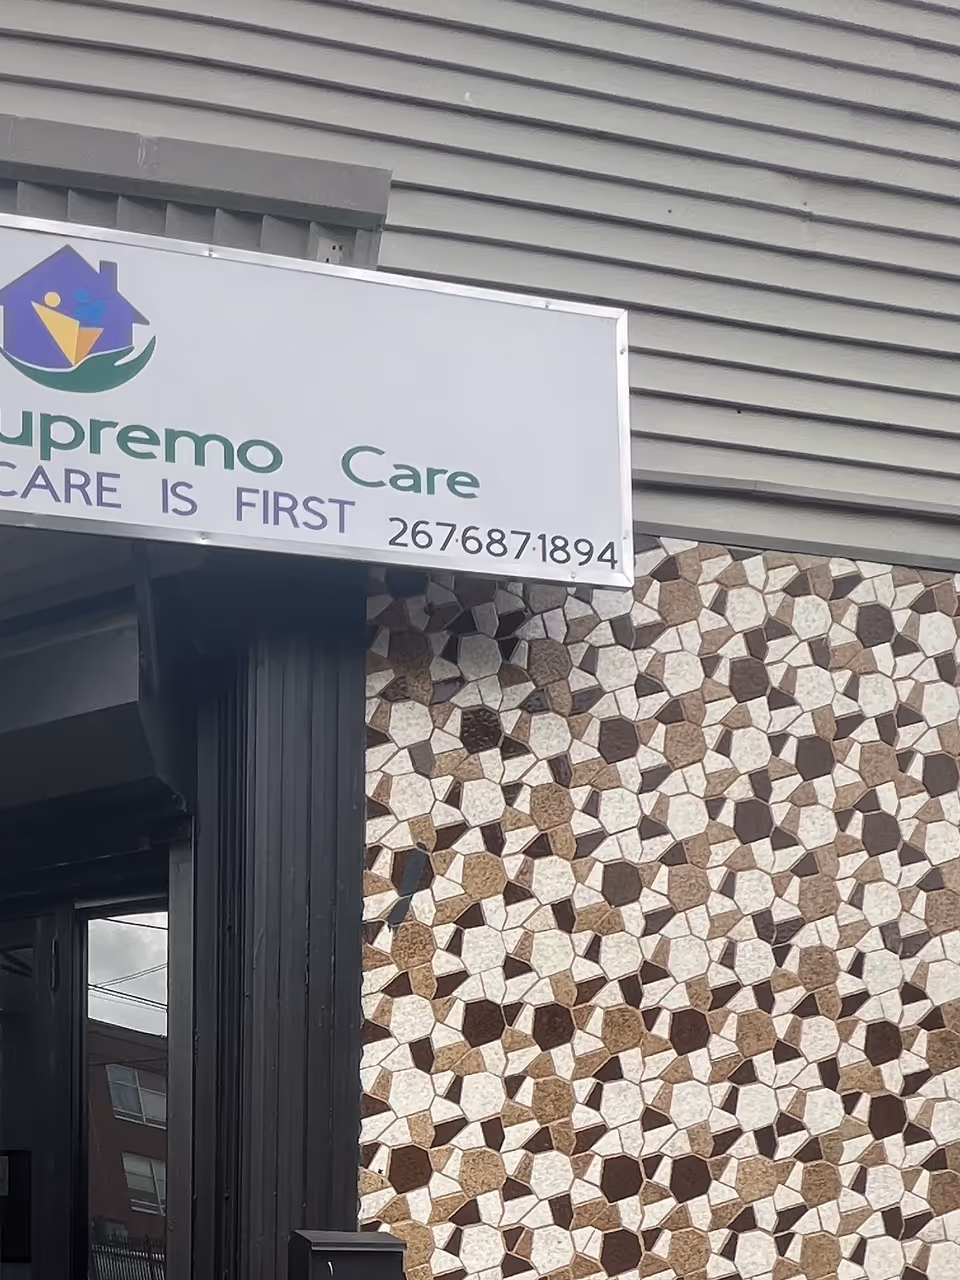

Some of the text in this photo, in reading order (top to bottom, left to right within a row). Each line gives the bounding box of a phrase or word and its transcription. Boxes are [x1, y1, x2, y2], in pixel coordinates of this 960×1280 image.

[342, 445, 481, 500] Care
[162, 478, 198, 517] IS
[237, 486, 356, 534] FIRST
